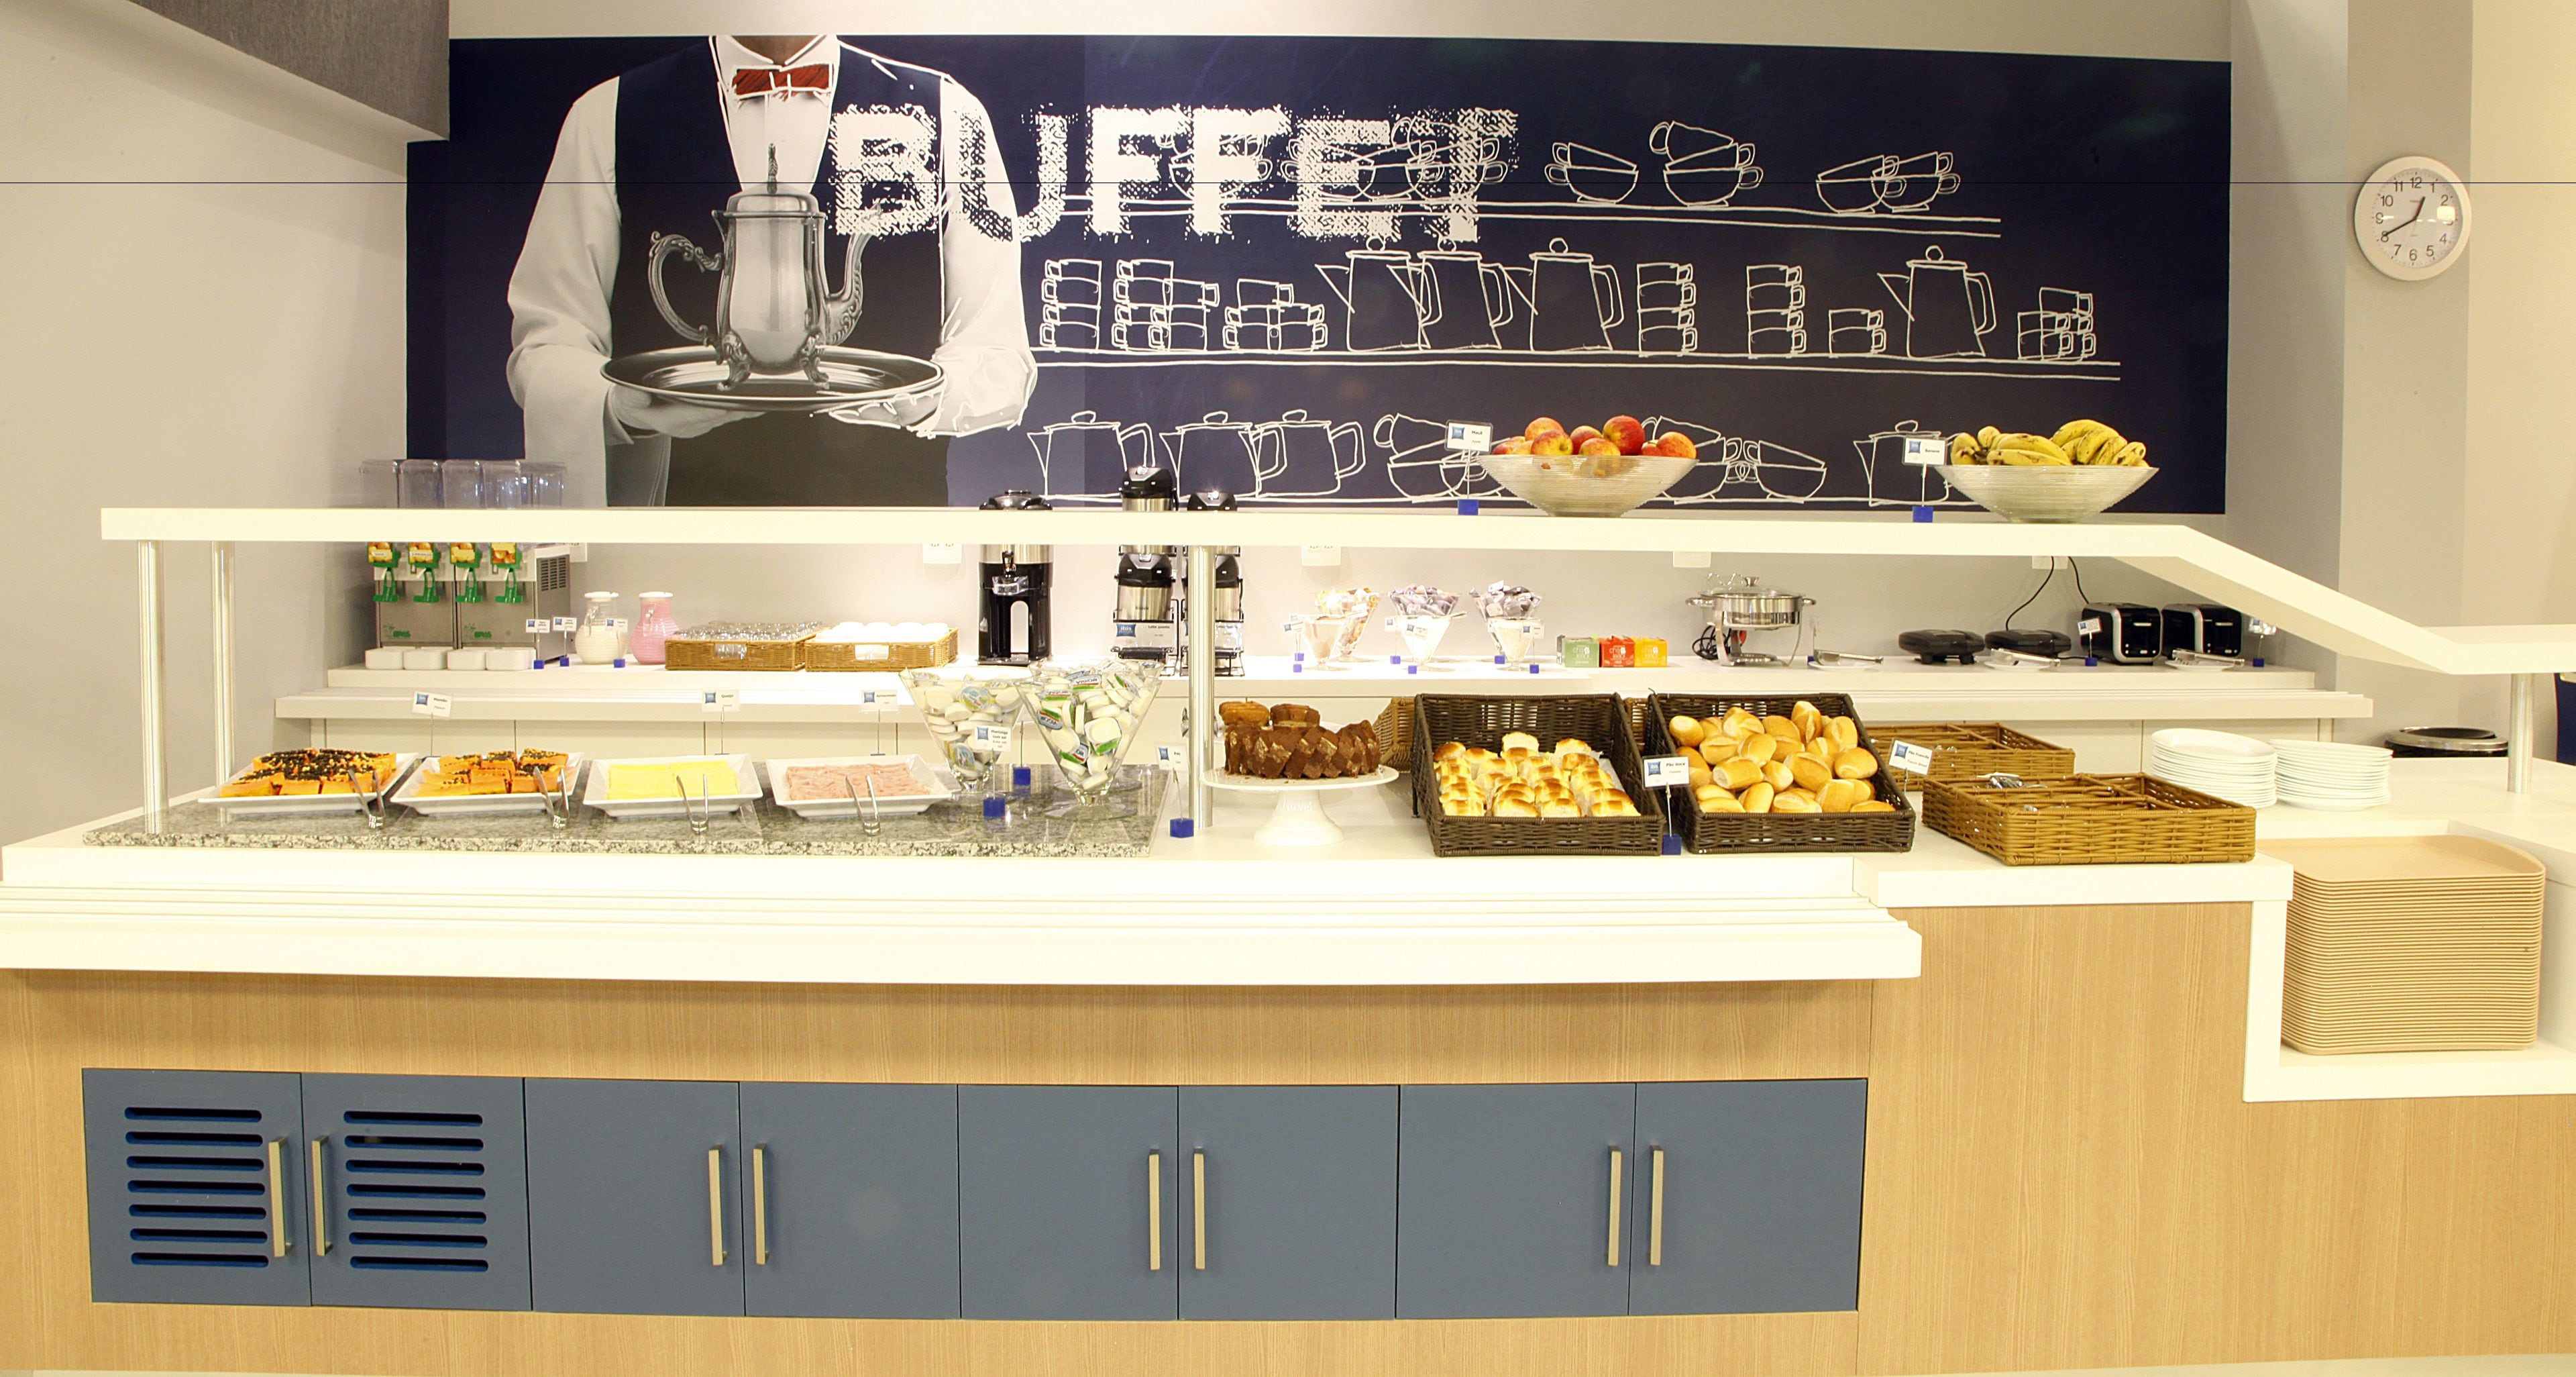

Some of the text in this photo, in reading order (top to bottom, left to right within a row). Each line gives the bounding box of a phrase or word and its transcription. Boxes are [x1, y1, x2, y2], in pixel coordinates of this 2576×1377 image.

[829, 105, 1517, 242] BUFFET
[2394, 181, 2403, 192] 11
[2410, 176, 2422, 189] 12
[2430, 182, 2435, 193] 1
[2381, 195, 2394, 207] 10
[2440, 194, 2449, 206] 2
[2375, 212, 2383, 224] 9
[2380, 231, 2389, 243] 8
[2439, 233, 2447, 244] 4
[2394, 244, 2402, 256] 7
[2409, 249, 2417, 260] 6
[2426, 245, 2434, 256] 5
